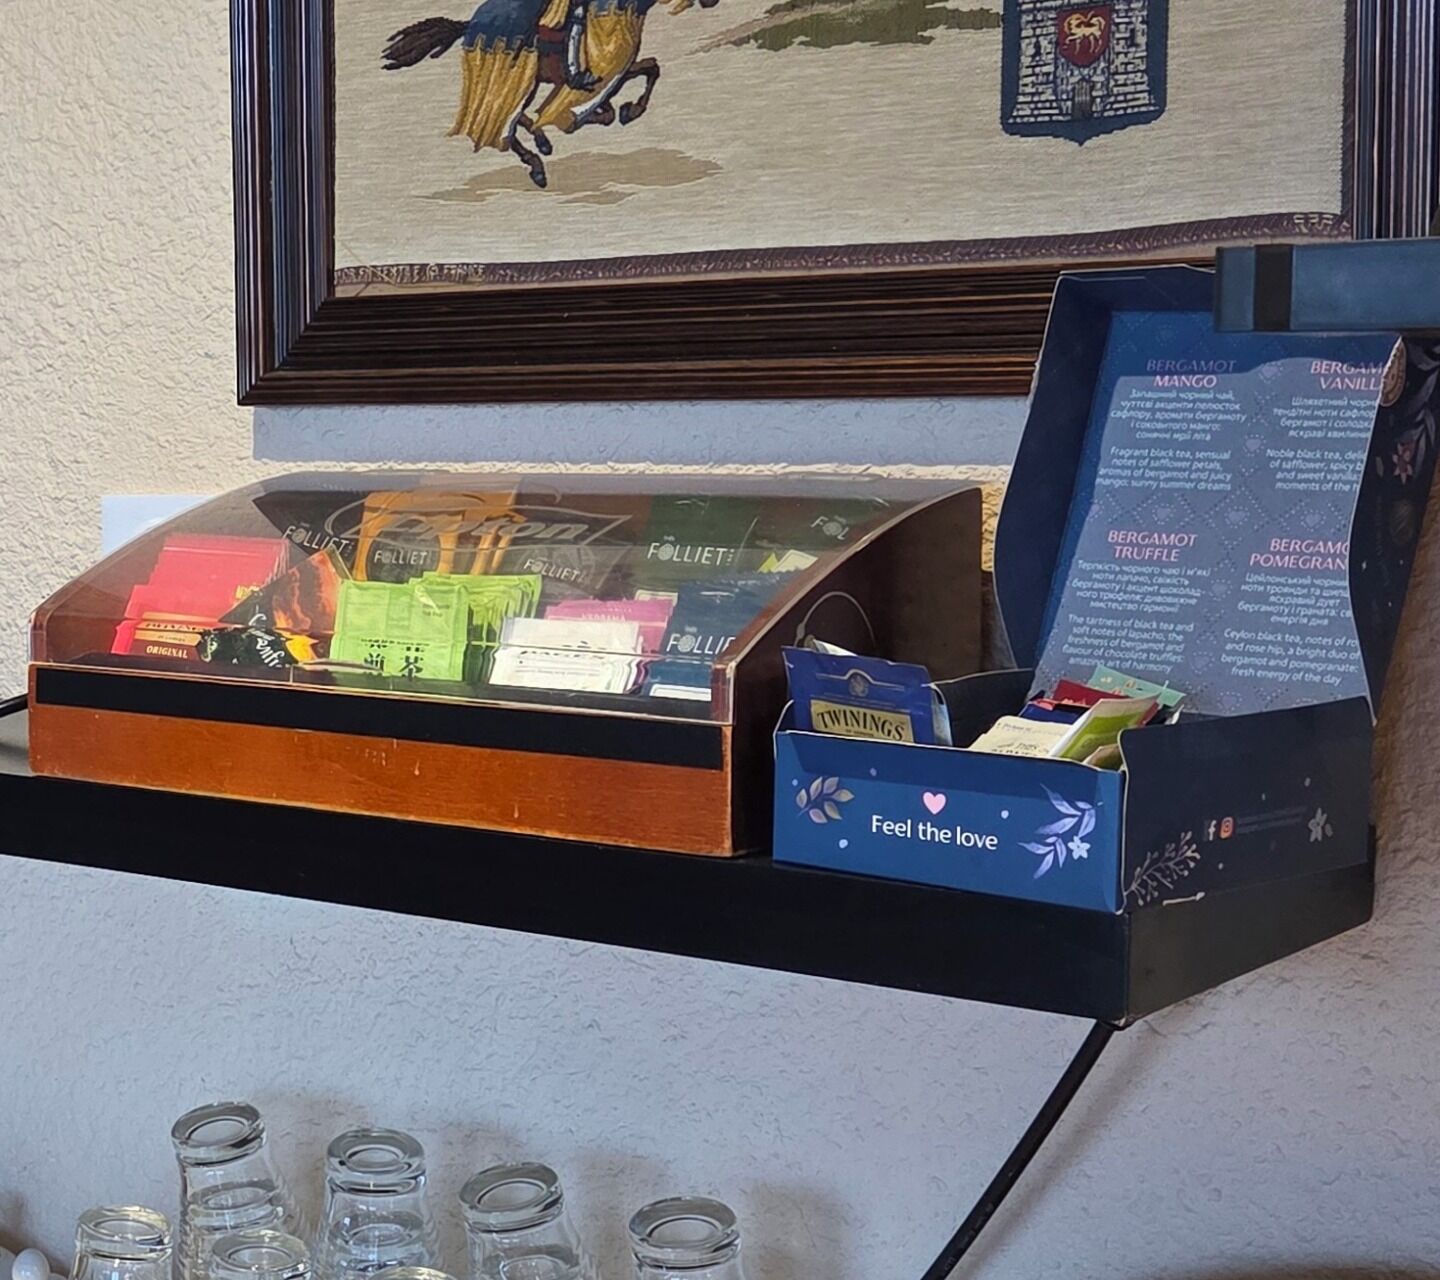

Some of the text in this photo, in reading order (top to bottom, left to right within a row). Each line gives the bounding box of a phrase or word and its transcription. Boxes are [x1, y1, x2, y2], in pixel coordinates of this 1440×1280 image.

[1147, 359, 1236, 373] BERGAMOT
[1311, 361, 1382, 375] BERGAM
[1153, 375, 1216, 388] MANGO
[1320, 377, 1379, 391] VANILL
[811, 515, 850, 541] FOL
[1108, 530, 1197, 547] BERGAMOT
[1270, 539, 1349, 555] BERGAM
[373, 548, 428, 566] FOLLIET
[646, 542, 727, 567] FOLLIET
[1113, 546, 1179, 562] TRUFFLE
[1250, 554, 1345, 571] POMEGRAN
[523, 558, 581, 583] FOLLIET
[145, 644, 189, 659] ORIGINAL
[817, 708, 906, 742] TWININGS
[871, 814, 999, 851] Feel the love
